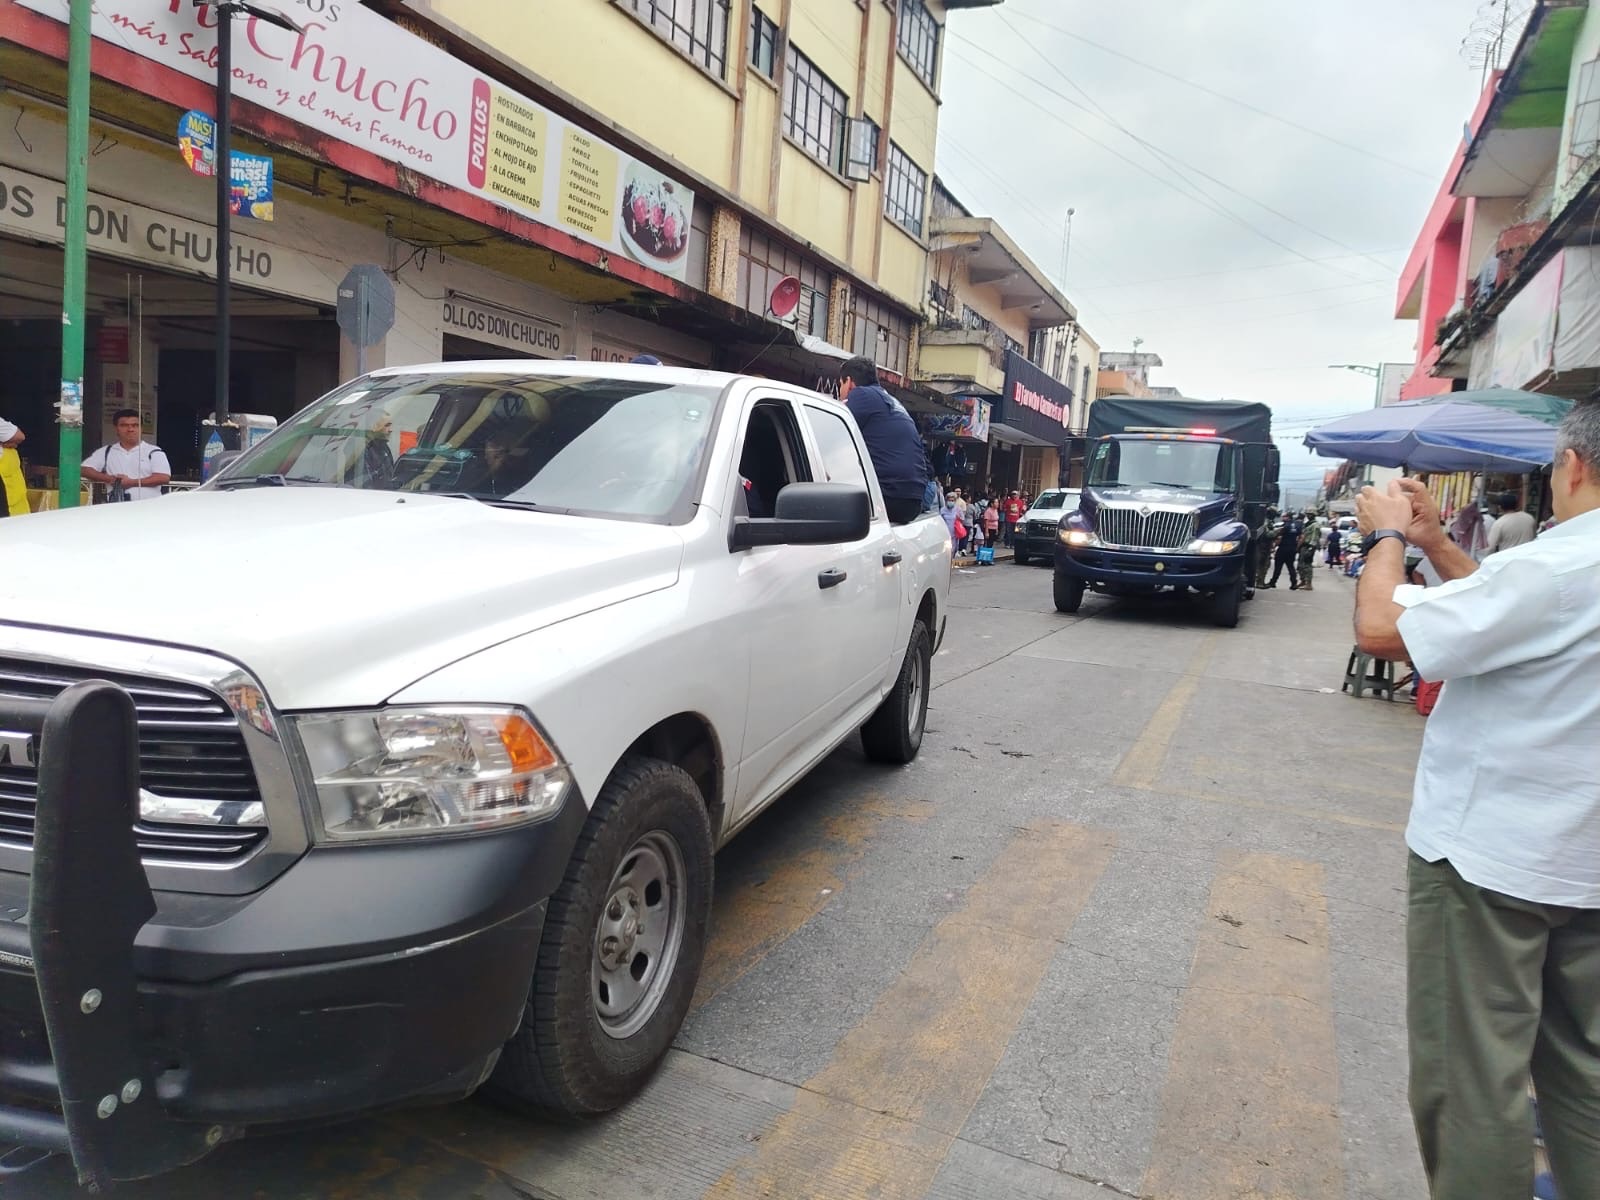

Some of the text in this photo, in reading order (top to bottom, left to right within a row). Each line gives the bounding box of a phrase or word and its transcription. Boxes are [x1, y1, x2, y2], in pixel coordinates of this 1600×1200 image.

[111, 13, 168, 46] más
[178, 32, 268, 89] Saboso
[275, 88, 290, 106] y
[298, 90, 316, 111] el
[322, 107, 362, 132] más
[369, 119, 433, 163] Famoso
[246, 15, 458, 141] Chucho
[497, 96, 534, 121] ROSTIZADOS
[471, 95, 488, 172] POLLOS
[496, 113, 536, 140] EN BARBACOA
[495, 130, 538, 157] ENCHIPOTLADO
[572, 146, 591, 160] ARROZ
[573, 134, 590, 148] CALDO
[231, 157, 262, 169] Habla
[494, 147, 537, 174] AL MOJO DE AJO
[571, 158, 599, 177] TORTILLAS
[493, 164, 526, 186] A LA CREMA
[569, 169, 599, 188] FRIJOLITOS
[492, 181, 541, 209] ENCACAHUATADO
[568, 193, 609, 217] AGUAS FRESCAS
[566, 216, 593, 232] CERVEZAS
[567, 204, 597, 223] REFRESCOS
[146, 223, 272, 278] CHUHO
[443, 303, 560, 351] OLLOS DON CHUCHO
